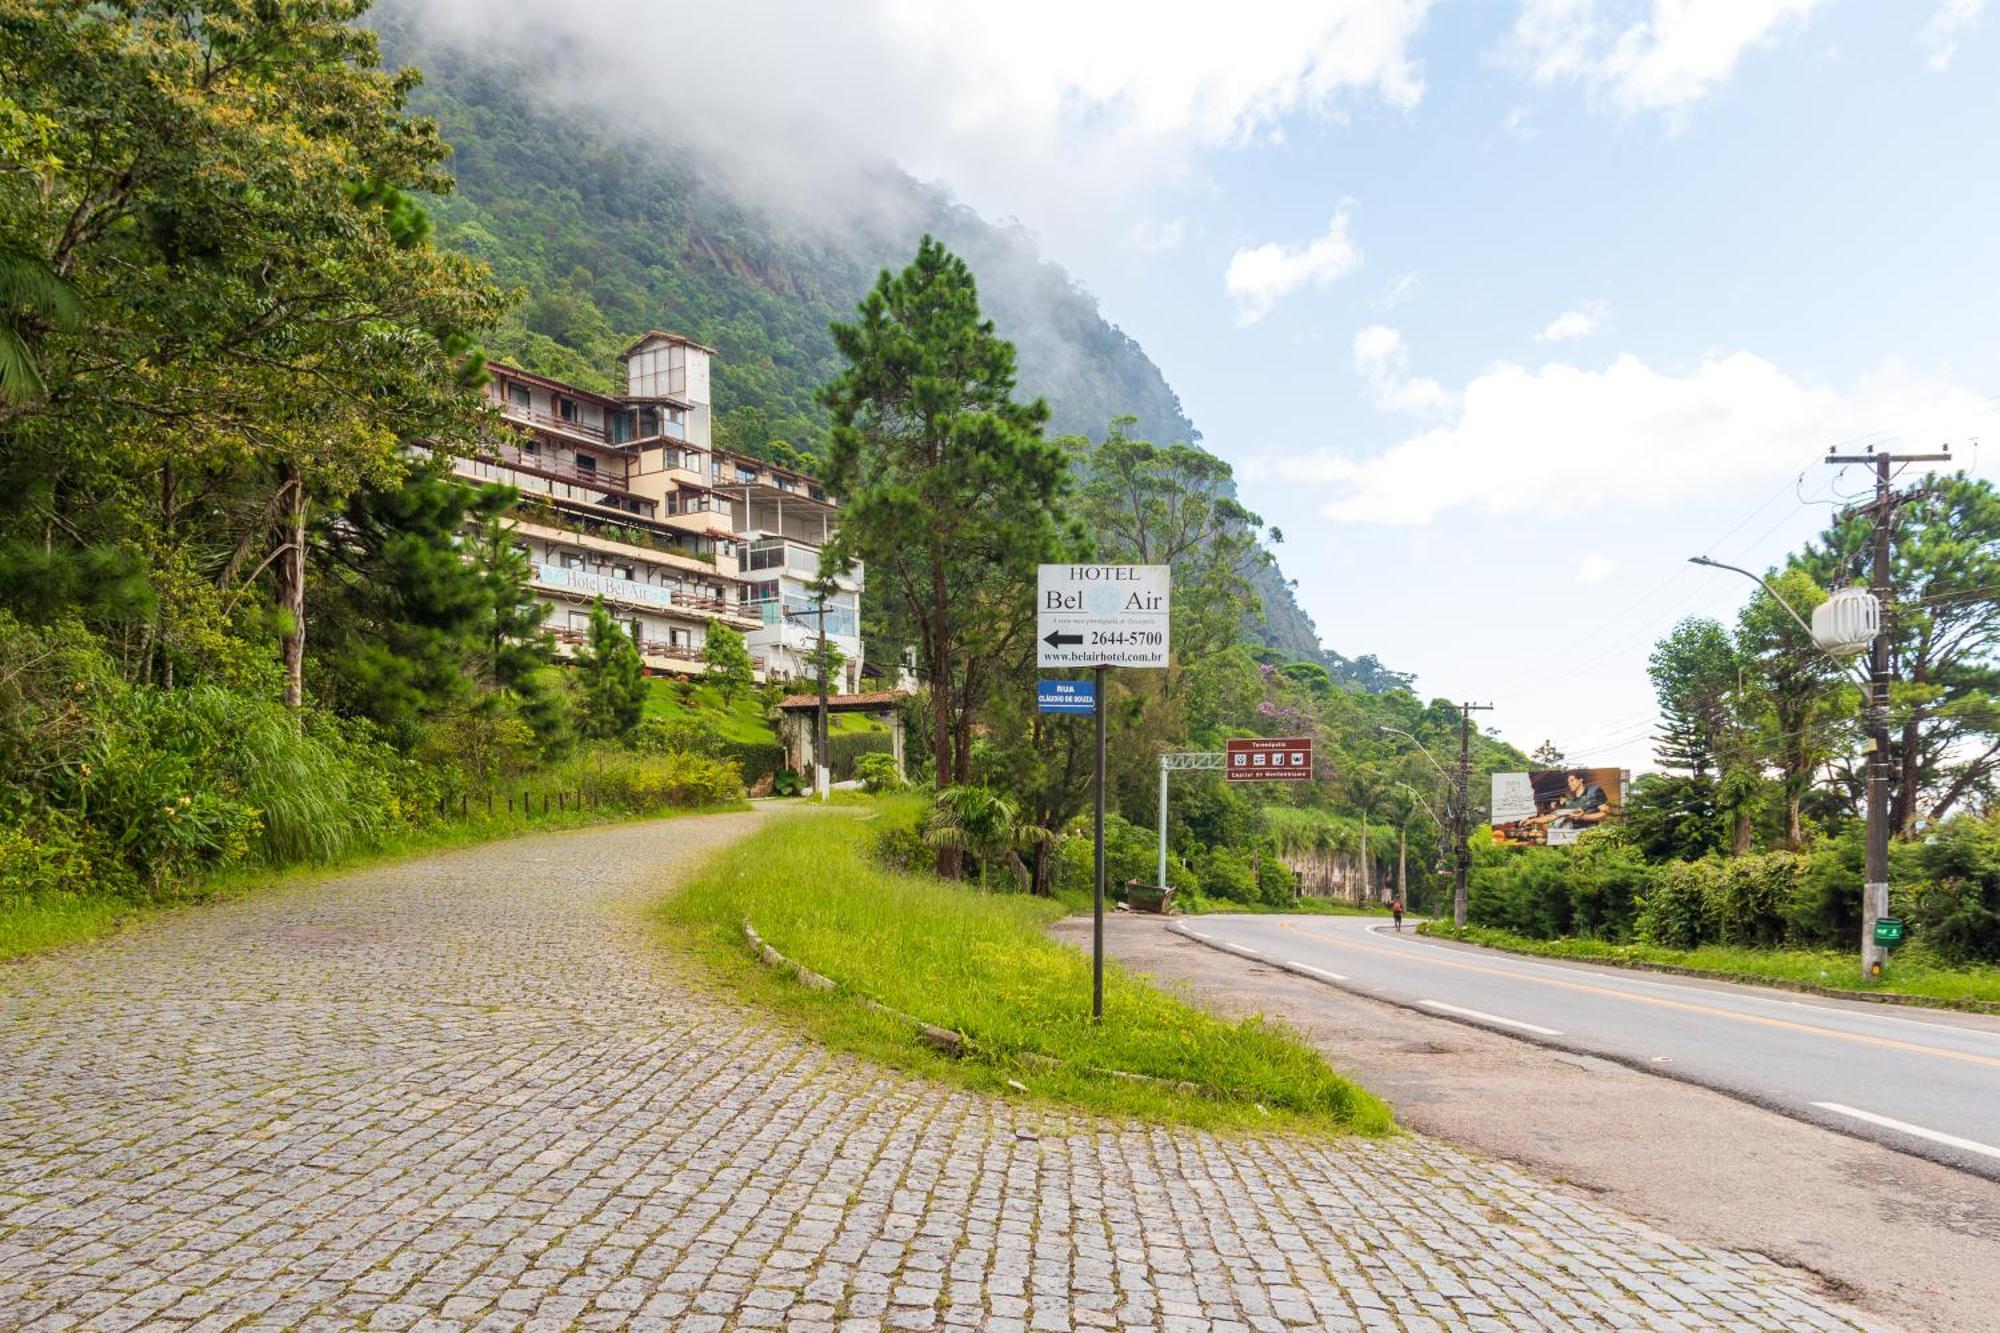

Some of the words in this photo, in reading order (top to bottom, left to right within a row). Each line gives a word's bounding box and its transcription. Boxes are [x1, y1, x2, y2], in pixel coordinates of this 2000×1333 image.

[1069, 567, 1141, 581] HOTEL
[567, 570, 600, 591] Hotel
[606, 578, 625, 596] Bel
[630, 584, 648, 600] Air
[1046, 590, 1083, 610] Bel
[1124, 590, 1163, 610] Air
[1091, 631, 1163, 646] 2644-5700
[1044, 651, 1164, 662] www.belairhotel.com.br
[1056, 685, 1075, 693] RUA
[1065, 695, 1073, 703] DE
